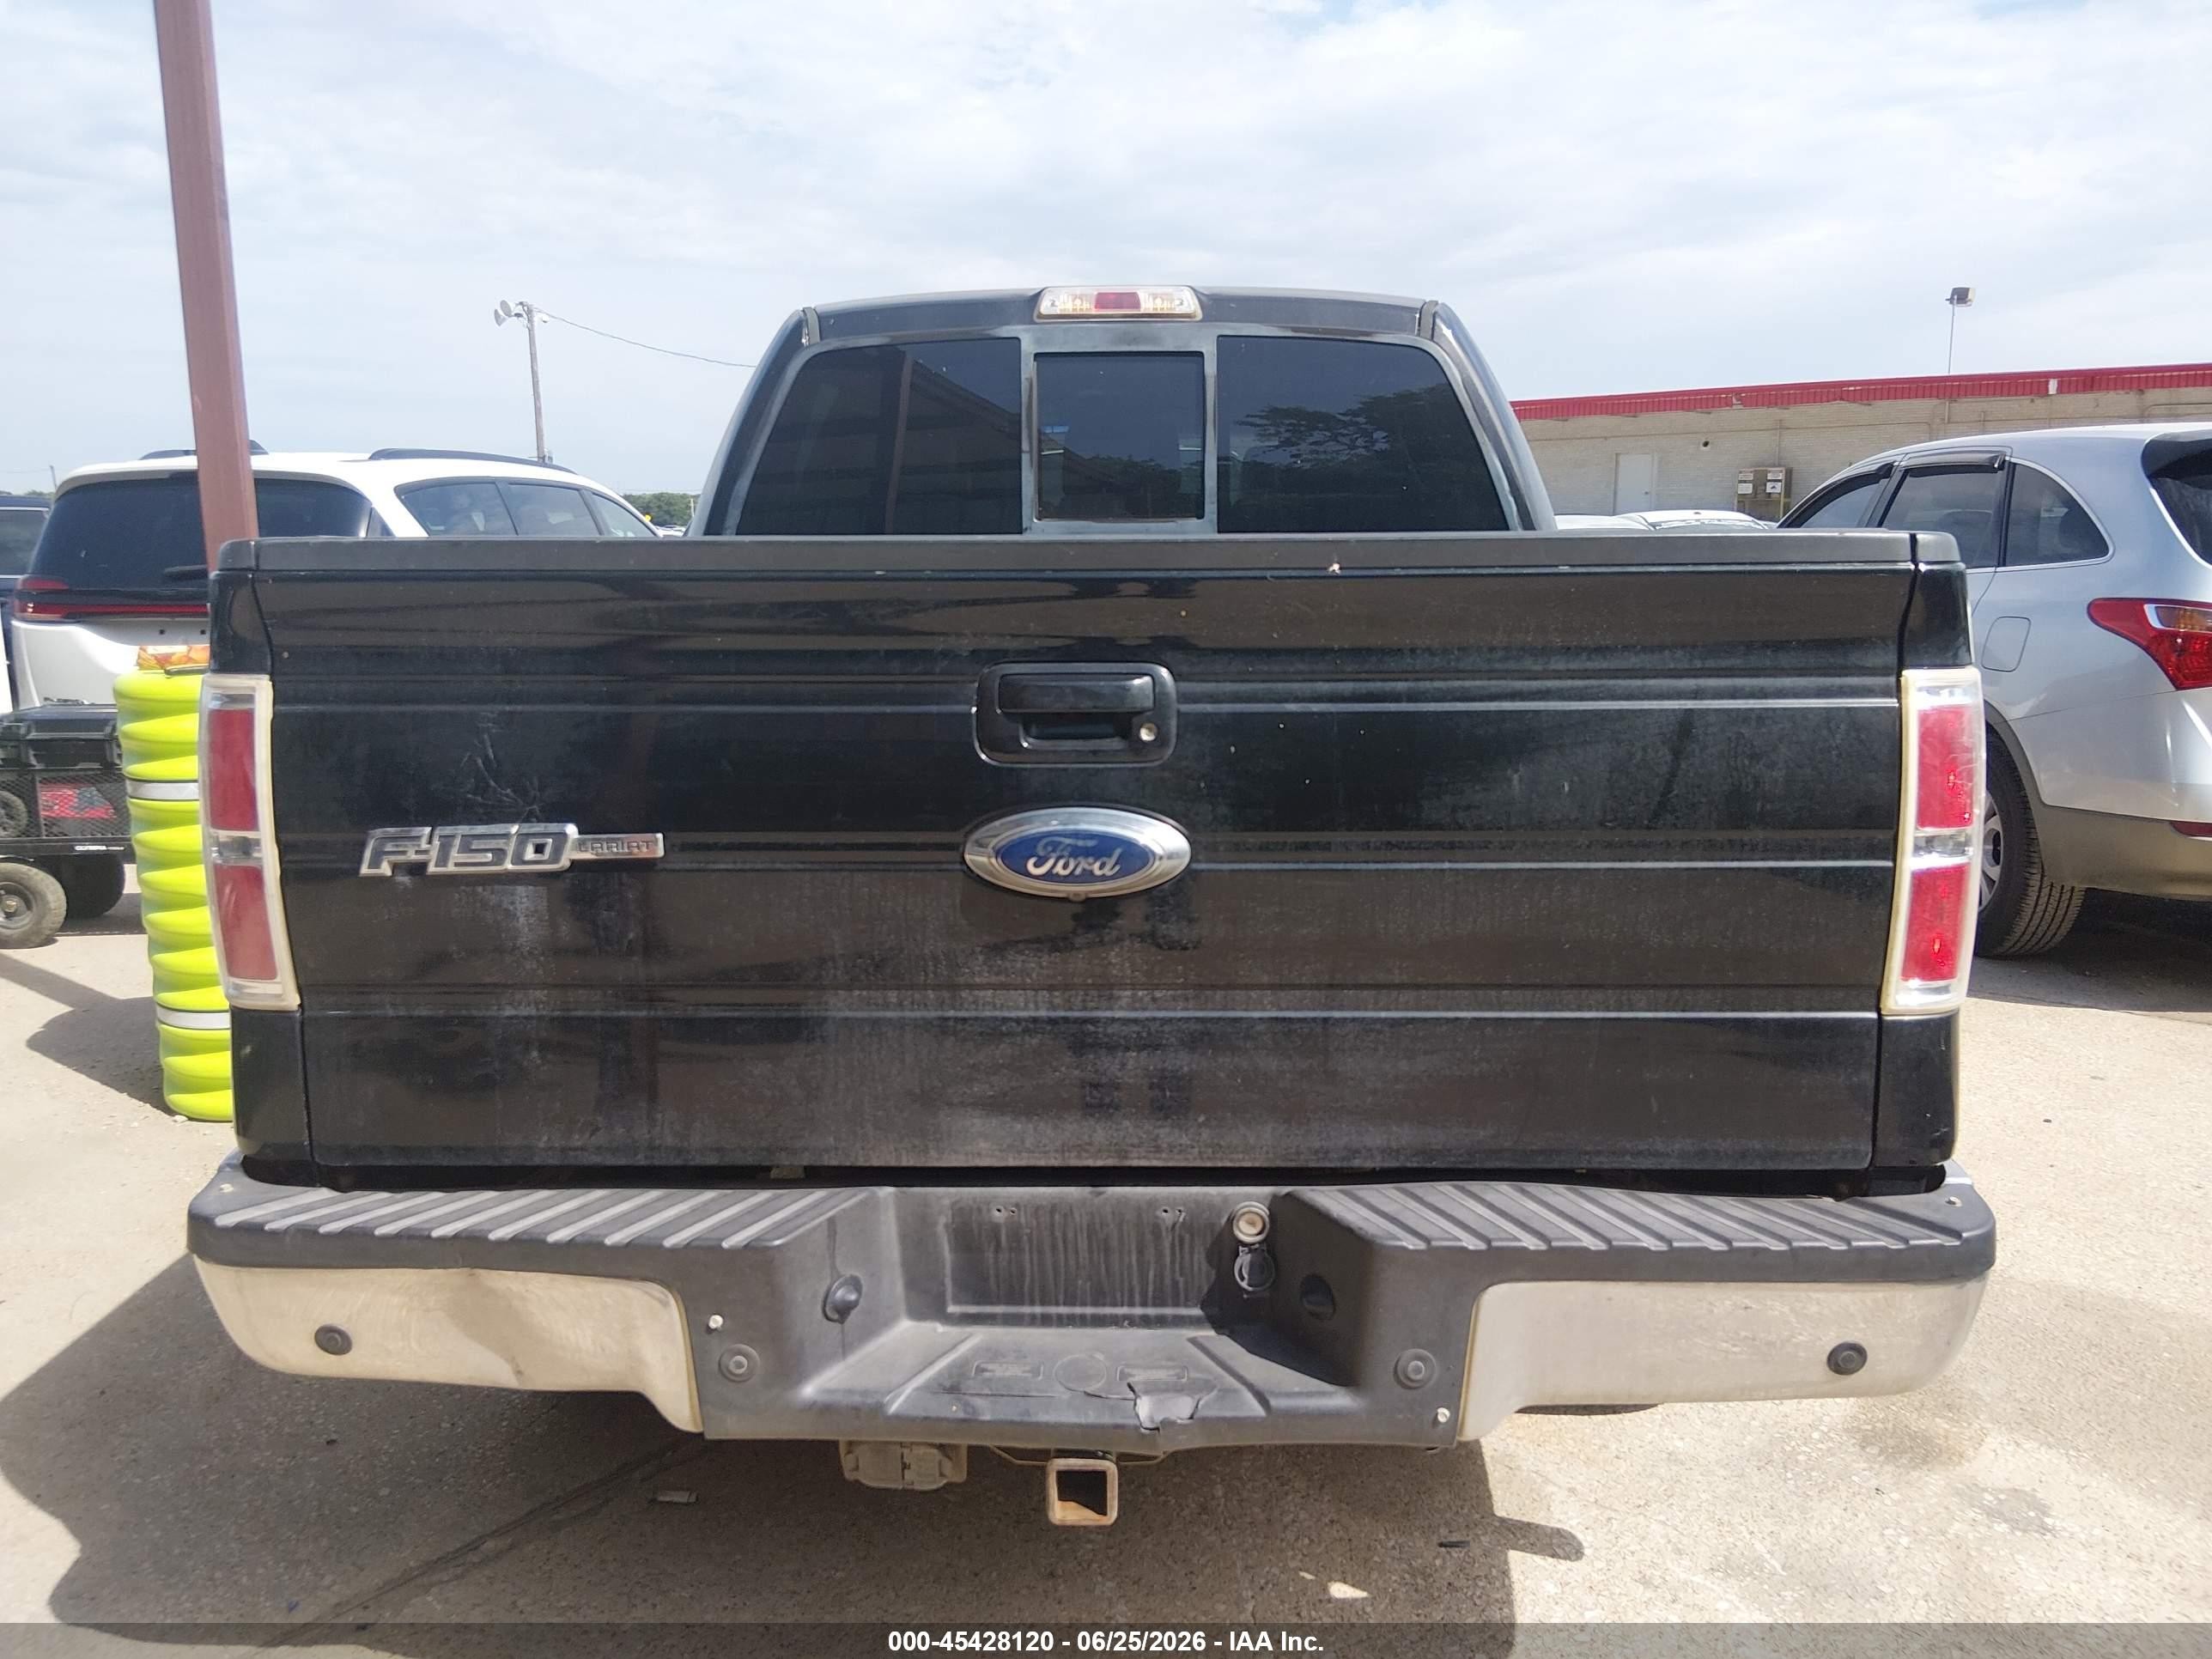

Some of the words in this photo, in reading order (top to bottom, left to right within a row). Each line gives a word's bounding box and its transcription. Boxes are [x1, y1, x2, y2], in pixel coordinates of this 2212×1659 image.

[360, 823, 577, 877] F-150
[578, 841, 653, 853] LARIAT
[1026, 836, 1122, 877] Ford
